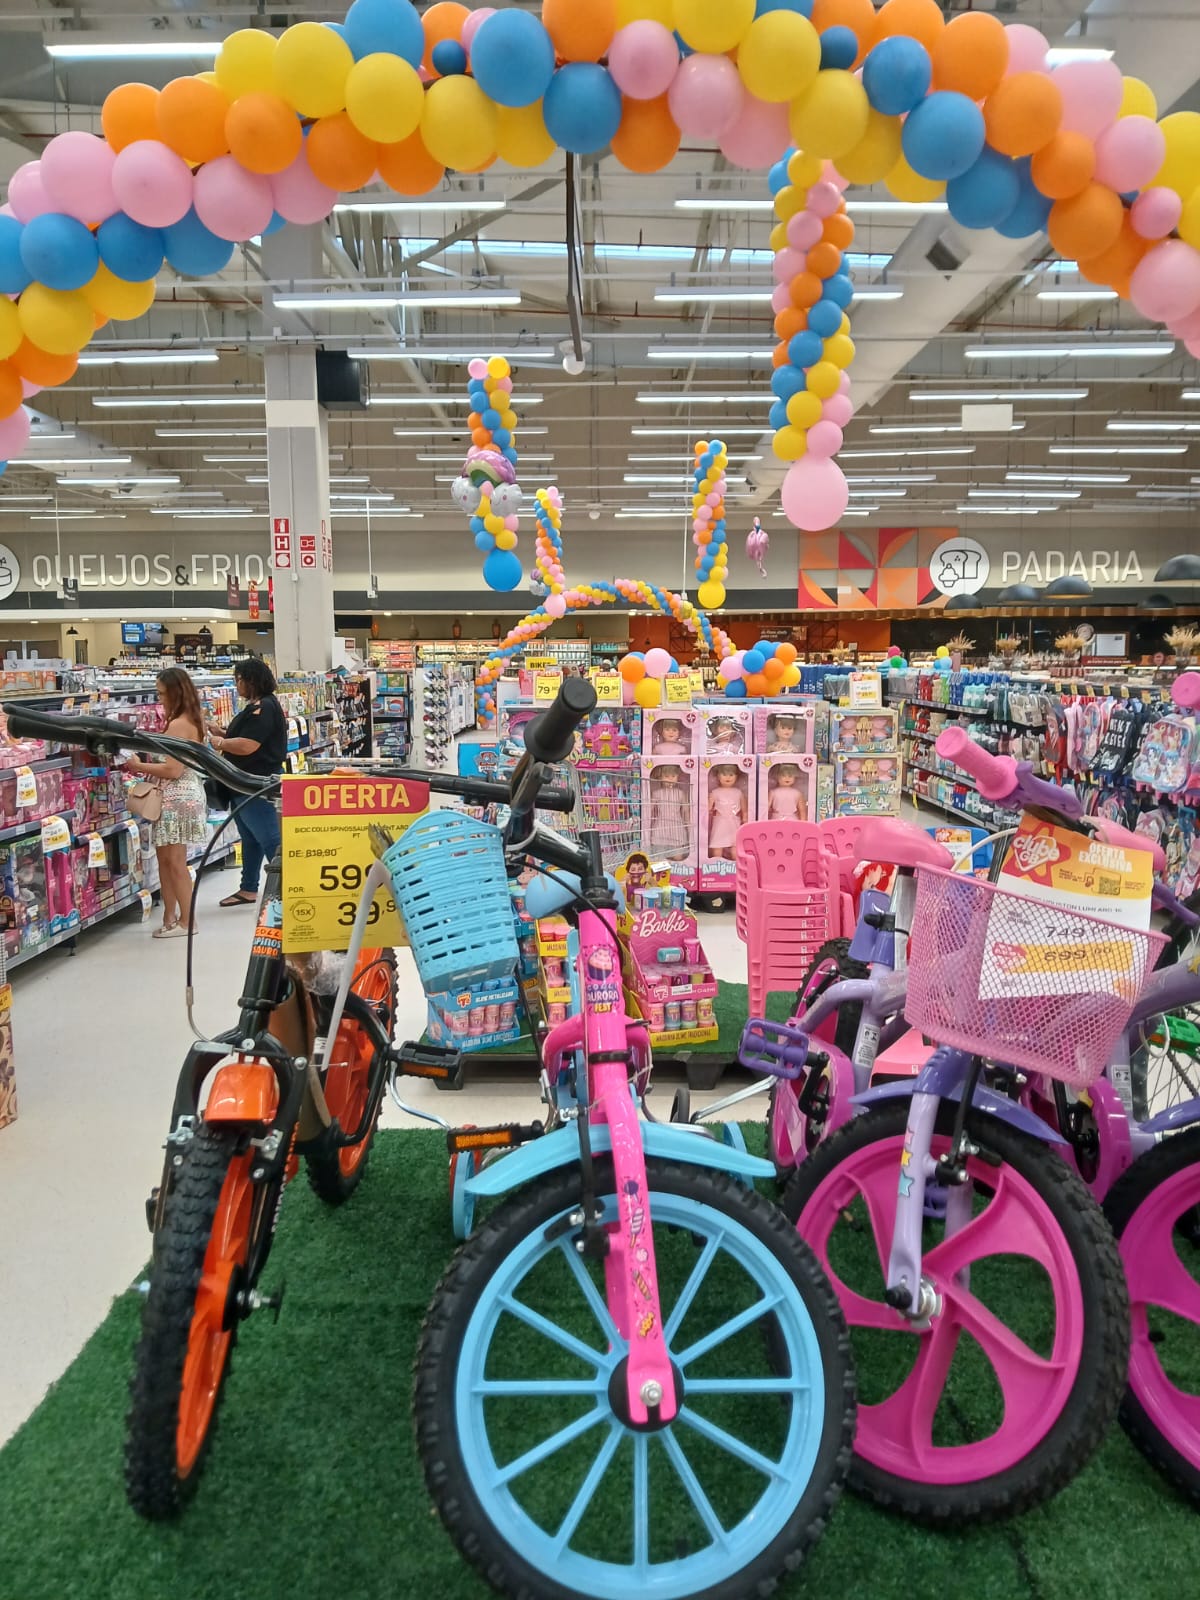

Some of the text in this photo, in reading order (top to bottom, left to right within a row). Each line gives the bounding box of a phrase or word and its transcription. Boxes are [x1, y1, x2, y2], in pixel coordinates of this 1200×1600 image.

[1002, 550, 1144, 583] PADARIA
[303, 783, 410, 810] OFERTA
[1013, 834, 1060, 861] clube
[1089, 842, 1126, 861] OFERTA
[1078, 850, 1133, 873] EXCLUSIVA
[295, 908, 312, 916] 15X
[640, 910, 690, 938] Barbie
[1045, 926, 1085, 938] 749
[1044, 949, 1087, 961] 699
[586, 990, 619, 1002] AURORA
[594, 1003, 612, 1013] FEST
